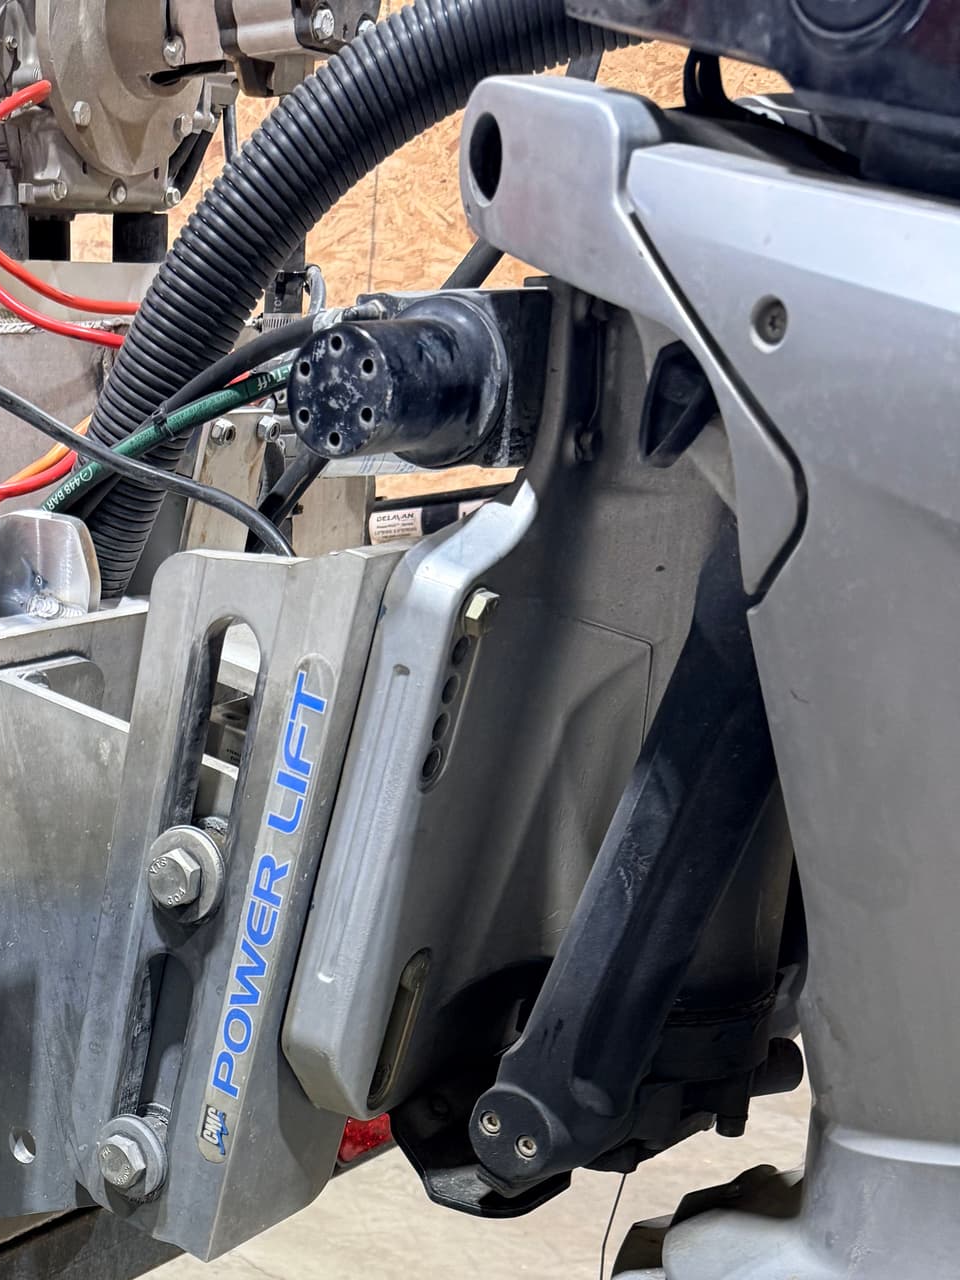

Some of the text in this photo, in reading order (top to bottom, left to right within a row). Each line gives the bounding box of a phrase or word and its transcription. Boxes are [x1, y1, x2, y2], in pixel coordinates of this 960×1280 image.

[46, 490, 65, 510] BAR
[266, 670, 328, 835] LIFT
[211, 853, 290, 1100] POWER
